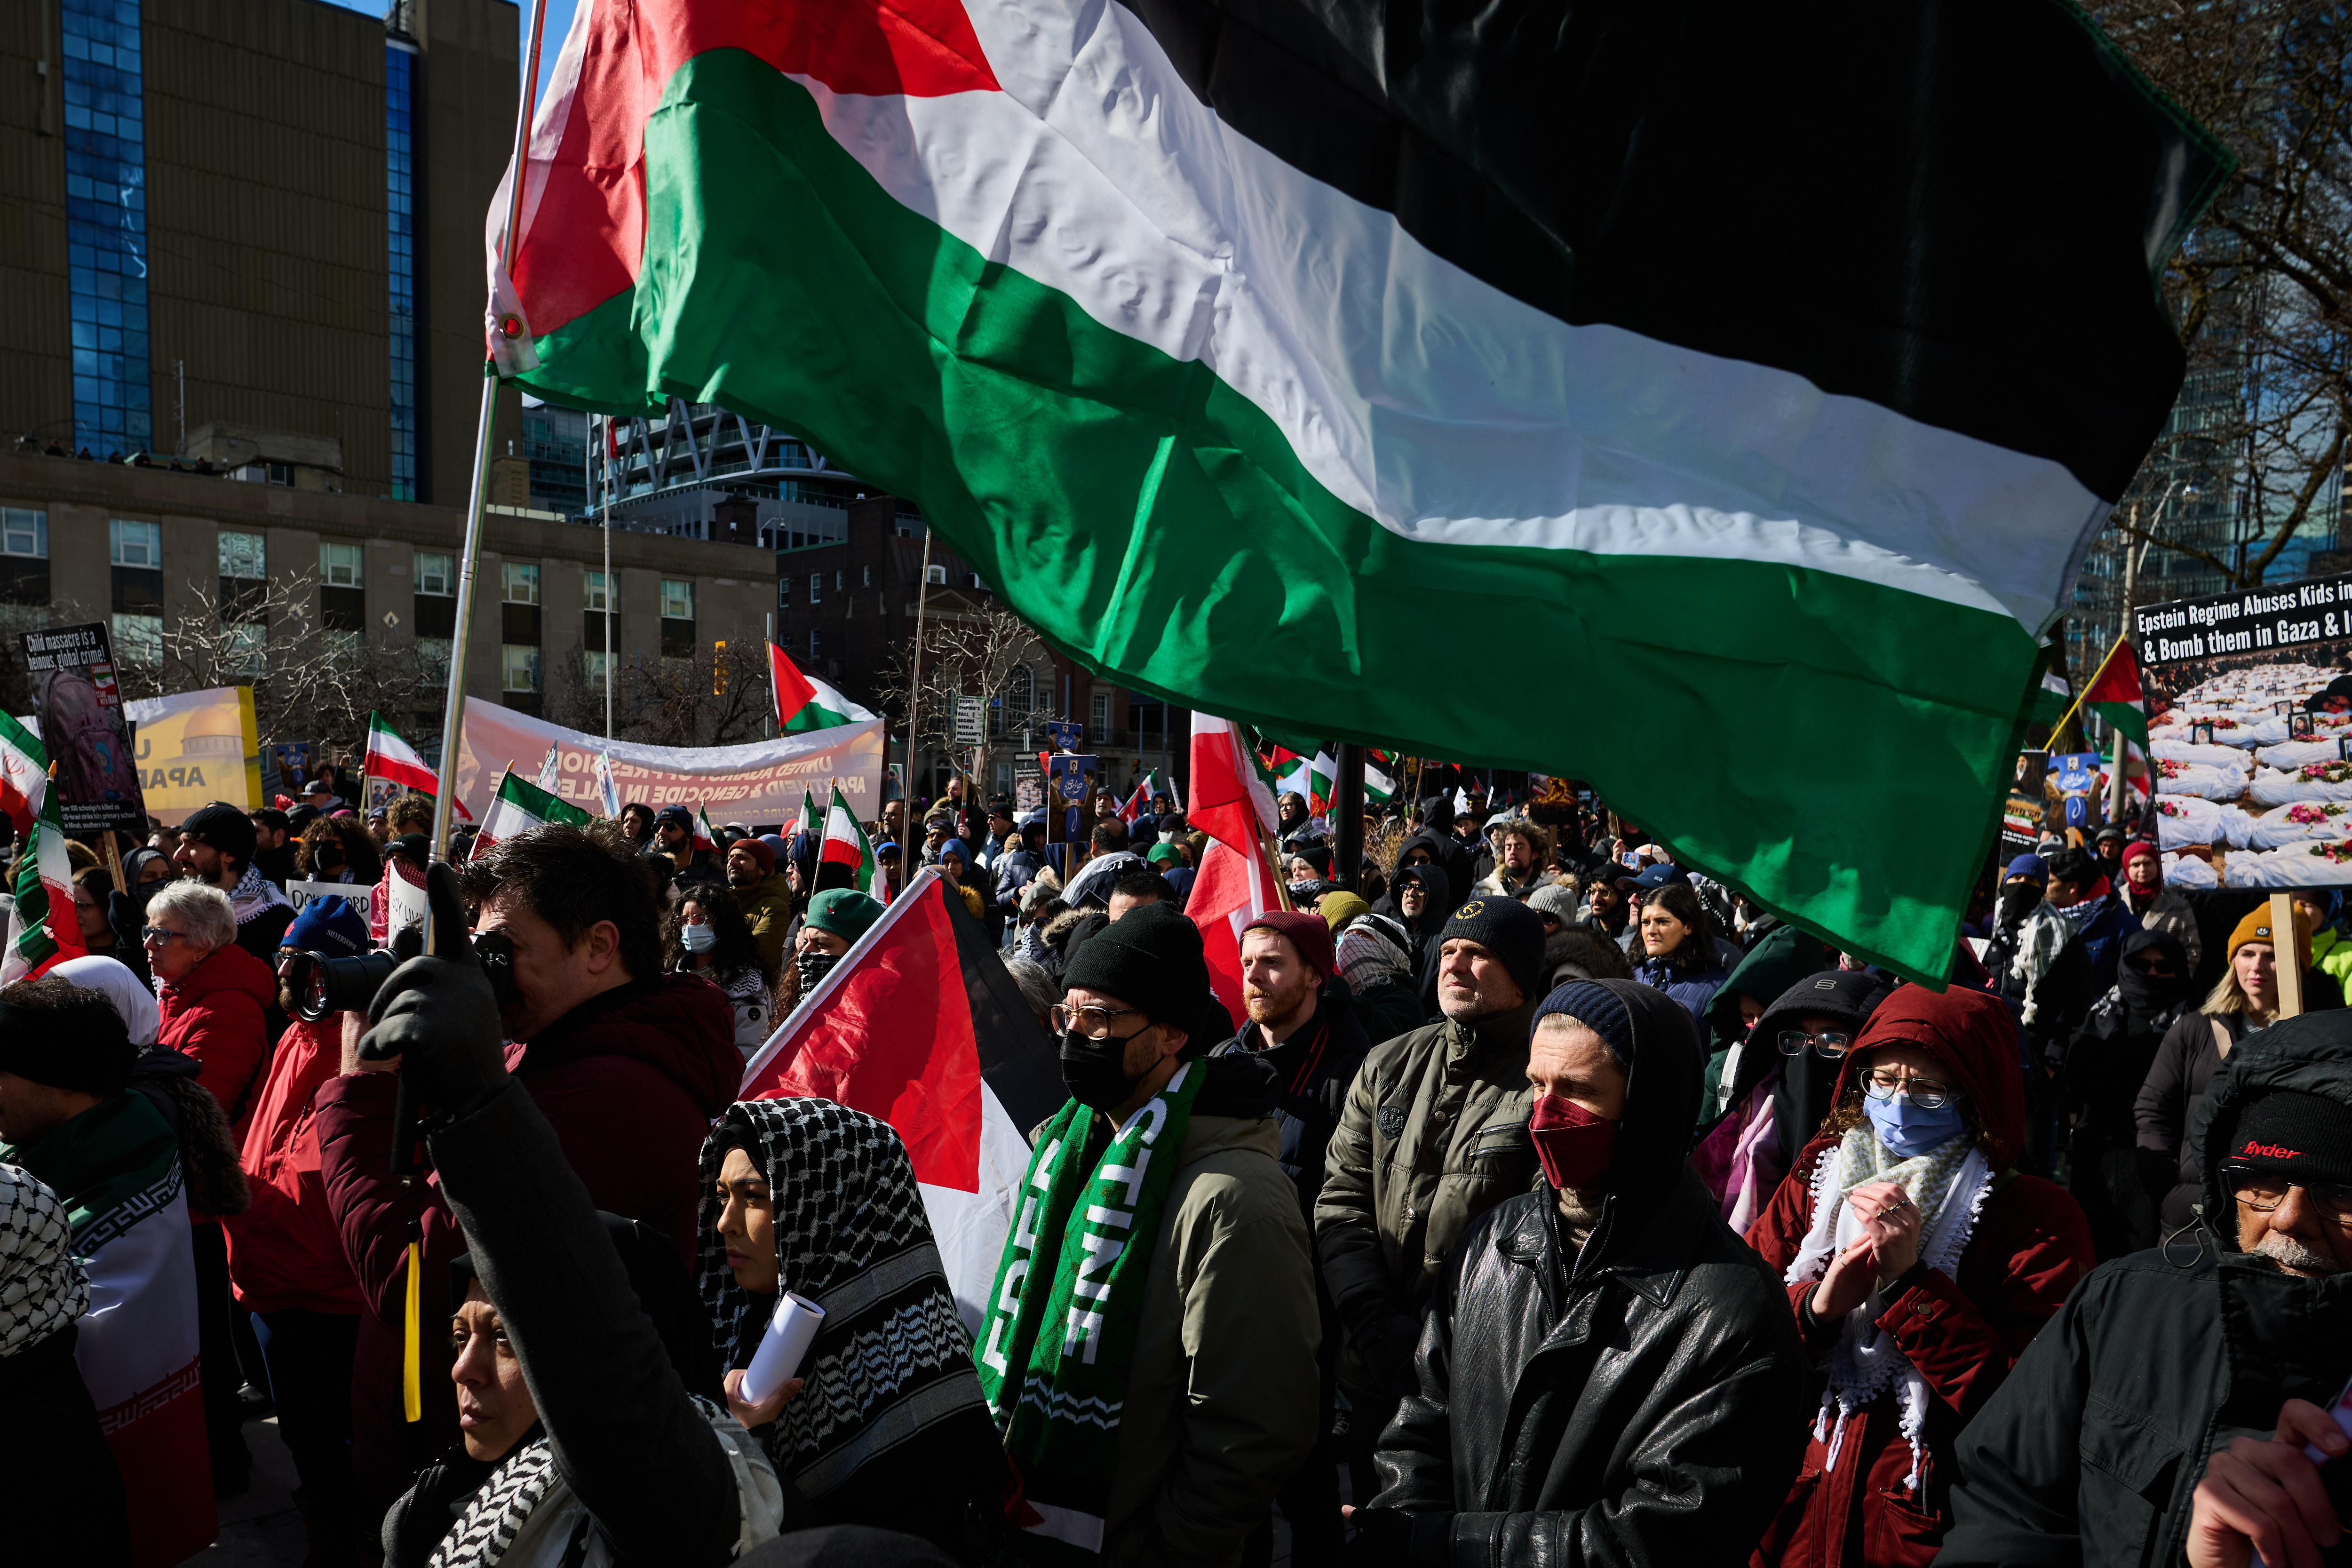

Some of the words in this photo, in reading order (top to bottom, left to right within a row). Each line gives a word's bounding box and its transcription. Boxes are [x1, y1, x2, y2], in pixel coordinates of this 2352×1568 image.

[2137, 608, 2185, 636] Epstein
[2189, 601, 2240, 627] Regime
[2244, 595, 2296, 616] Abuses
[2300, 583, 2334, 607] Kids
[2338, 581, 2352, 601] in
[26, 633, 45, 653] Child
[46, 633, 80, 650] massacre
[80, 628, 89, 645] is
[90, 631, 96, 644] a
[2144, 640, 2156, 663] &
[2159, 633, 2204, 661] Bomb
[2207, 629, 2251, 654] them
[2256, 624, 2273, 647] in
[2277, 619, 2320, 644] Gaza
[2325, 612, 2339, 637] &
[27, 653, 57, 671] heinous,
[57, 648, 80, 671] global
[80, 645, 106, 665] crime!
[92, 665, 112, 673] CANADIANS
[108, 694, 118, 704] IRAN
[79, 804, 101, 812] schoolgirls
[339, 895, 369, 914] ORD
[2243, 1141, 2302, 1159] Ryder
